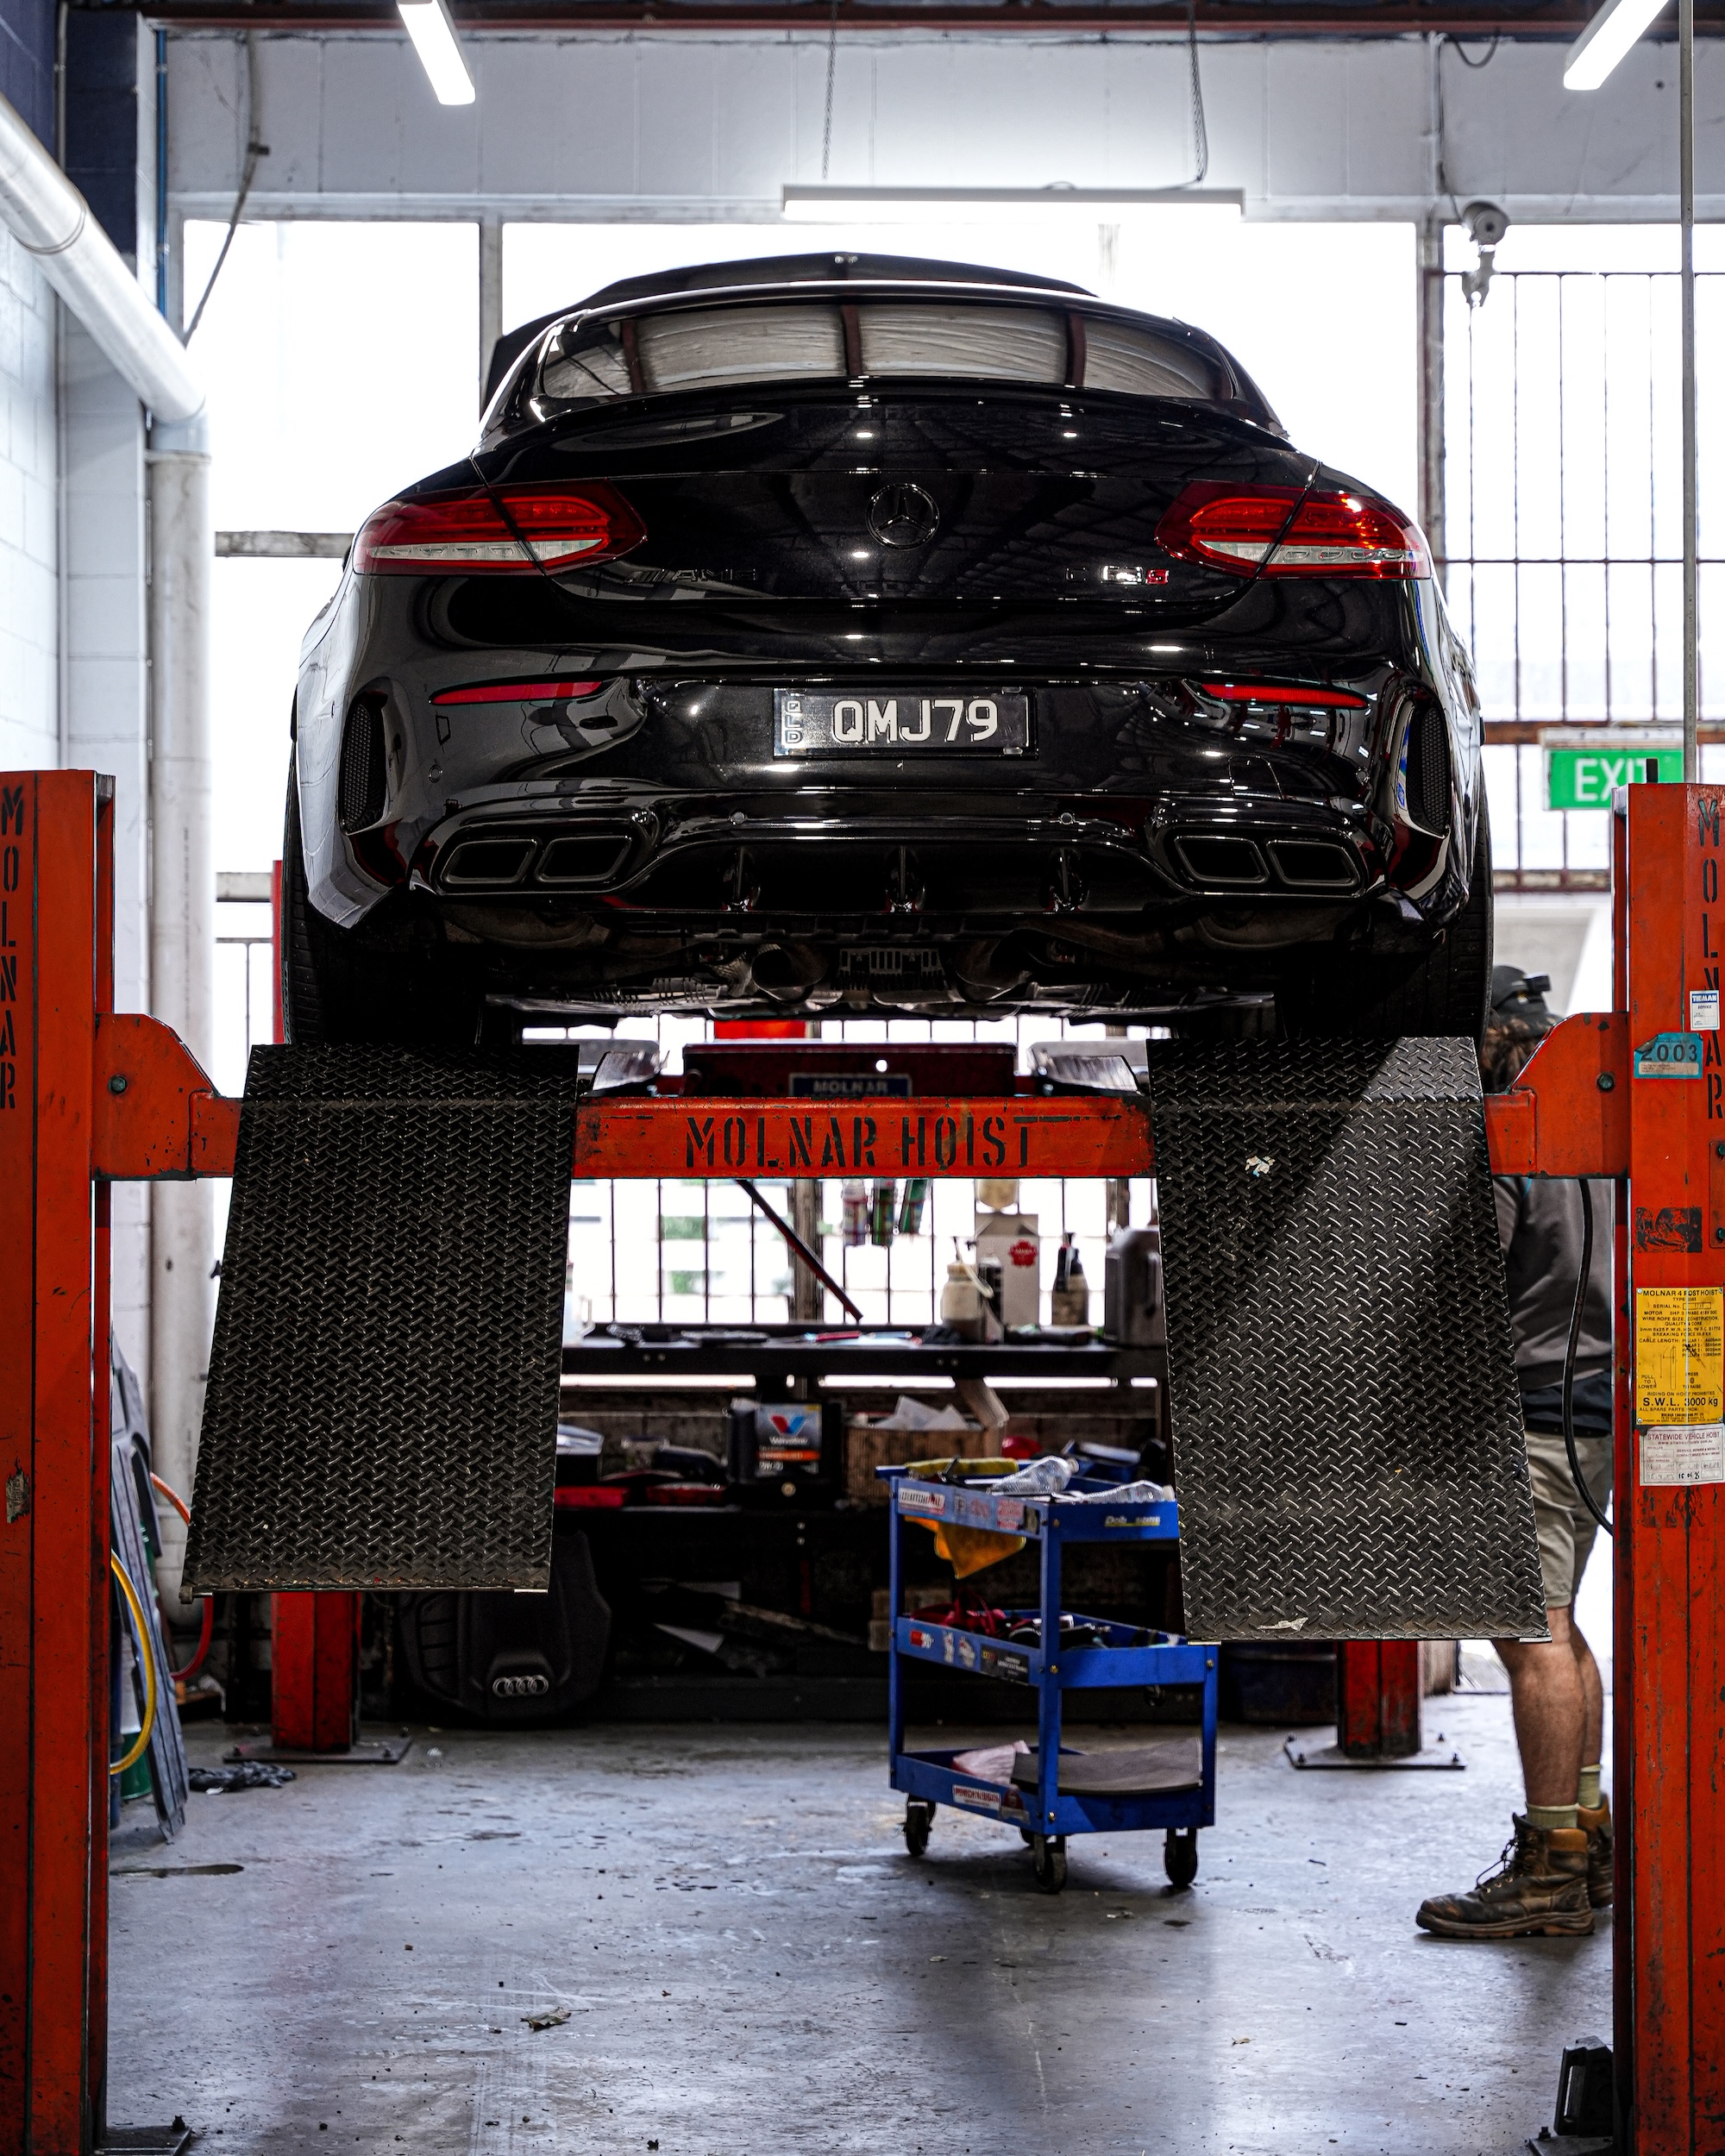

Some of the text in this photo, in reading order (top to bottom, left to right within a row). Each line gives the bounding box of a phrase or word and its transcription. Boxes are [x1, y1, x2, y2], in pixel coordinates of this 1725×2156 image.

[784, 699, 803, 744] QLD
[832, 699, 998, 744] QMJ79
[1574, 758, 1647, 802] EXI
[1, 785, 23, 1108] MOLNAR
[812, 1080, 888, 1094] MOLNAR
[686, 1116, 1035, 1168] MOLNAR HOIST
[1643, 1396, 1718, 1407] S.W.L. 3000 kg
